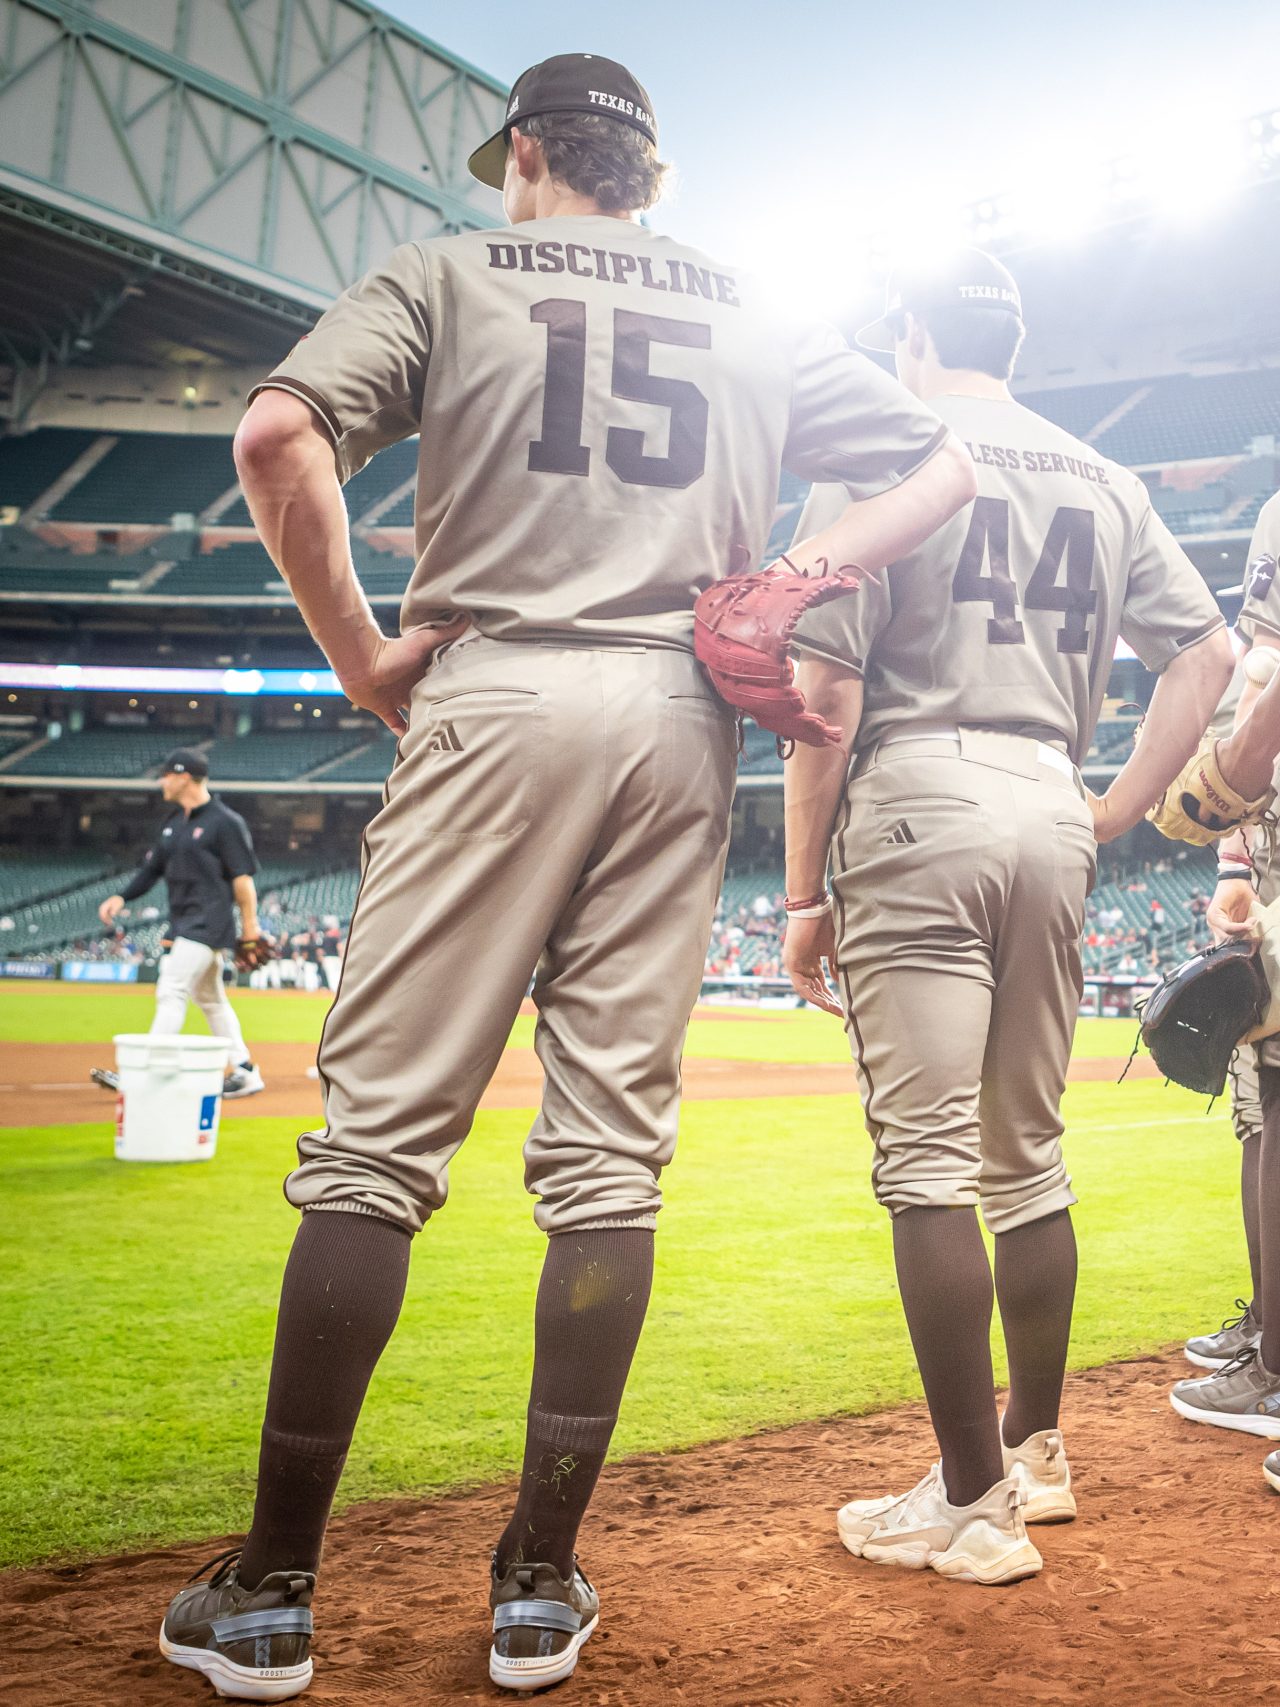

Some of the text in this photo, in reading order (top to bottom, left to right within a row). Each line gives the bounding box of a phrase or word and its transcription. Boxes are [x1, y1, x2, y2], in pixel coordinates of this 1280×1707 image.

[588, 90, 634, 116] TEXAS
[487, 241, 741, 308] DISCIPLINE
[959, 285, 999, 299] TEXAS
[528, 297, 712, 490] 15
[1023, 450, 1110, 486] SERVICE
[951, 495, 1098, 655] 44
